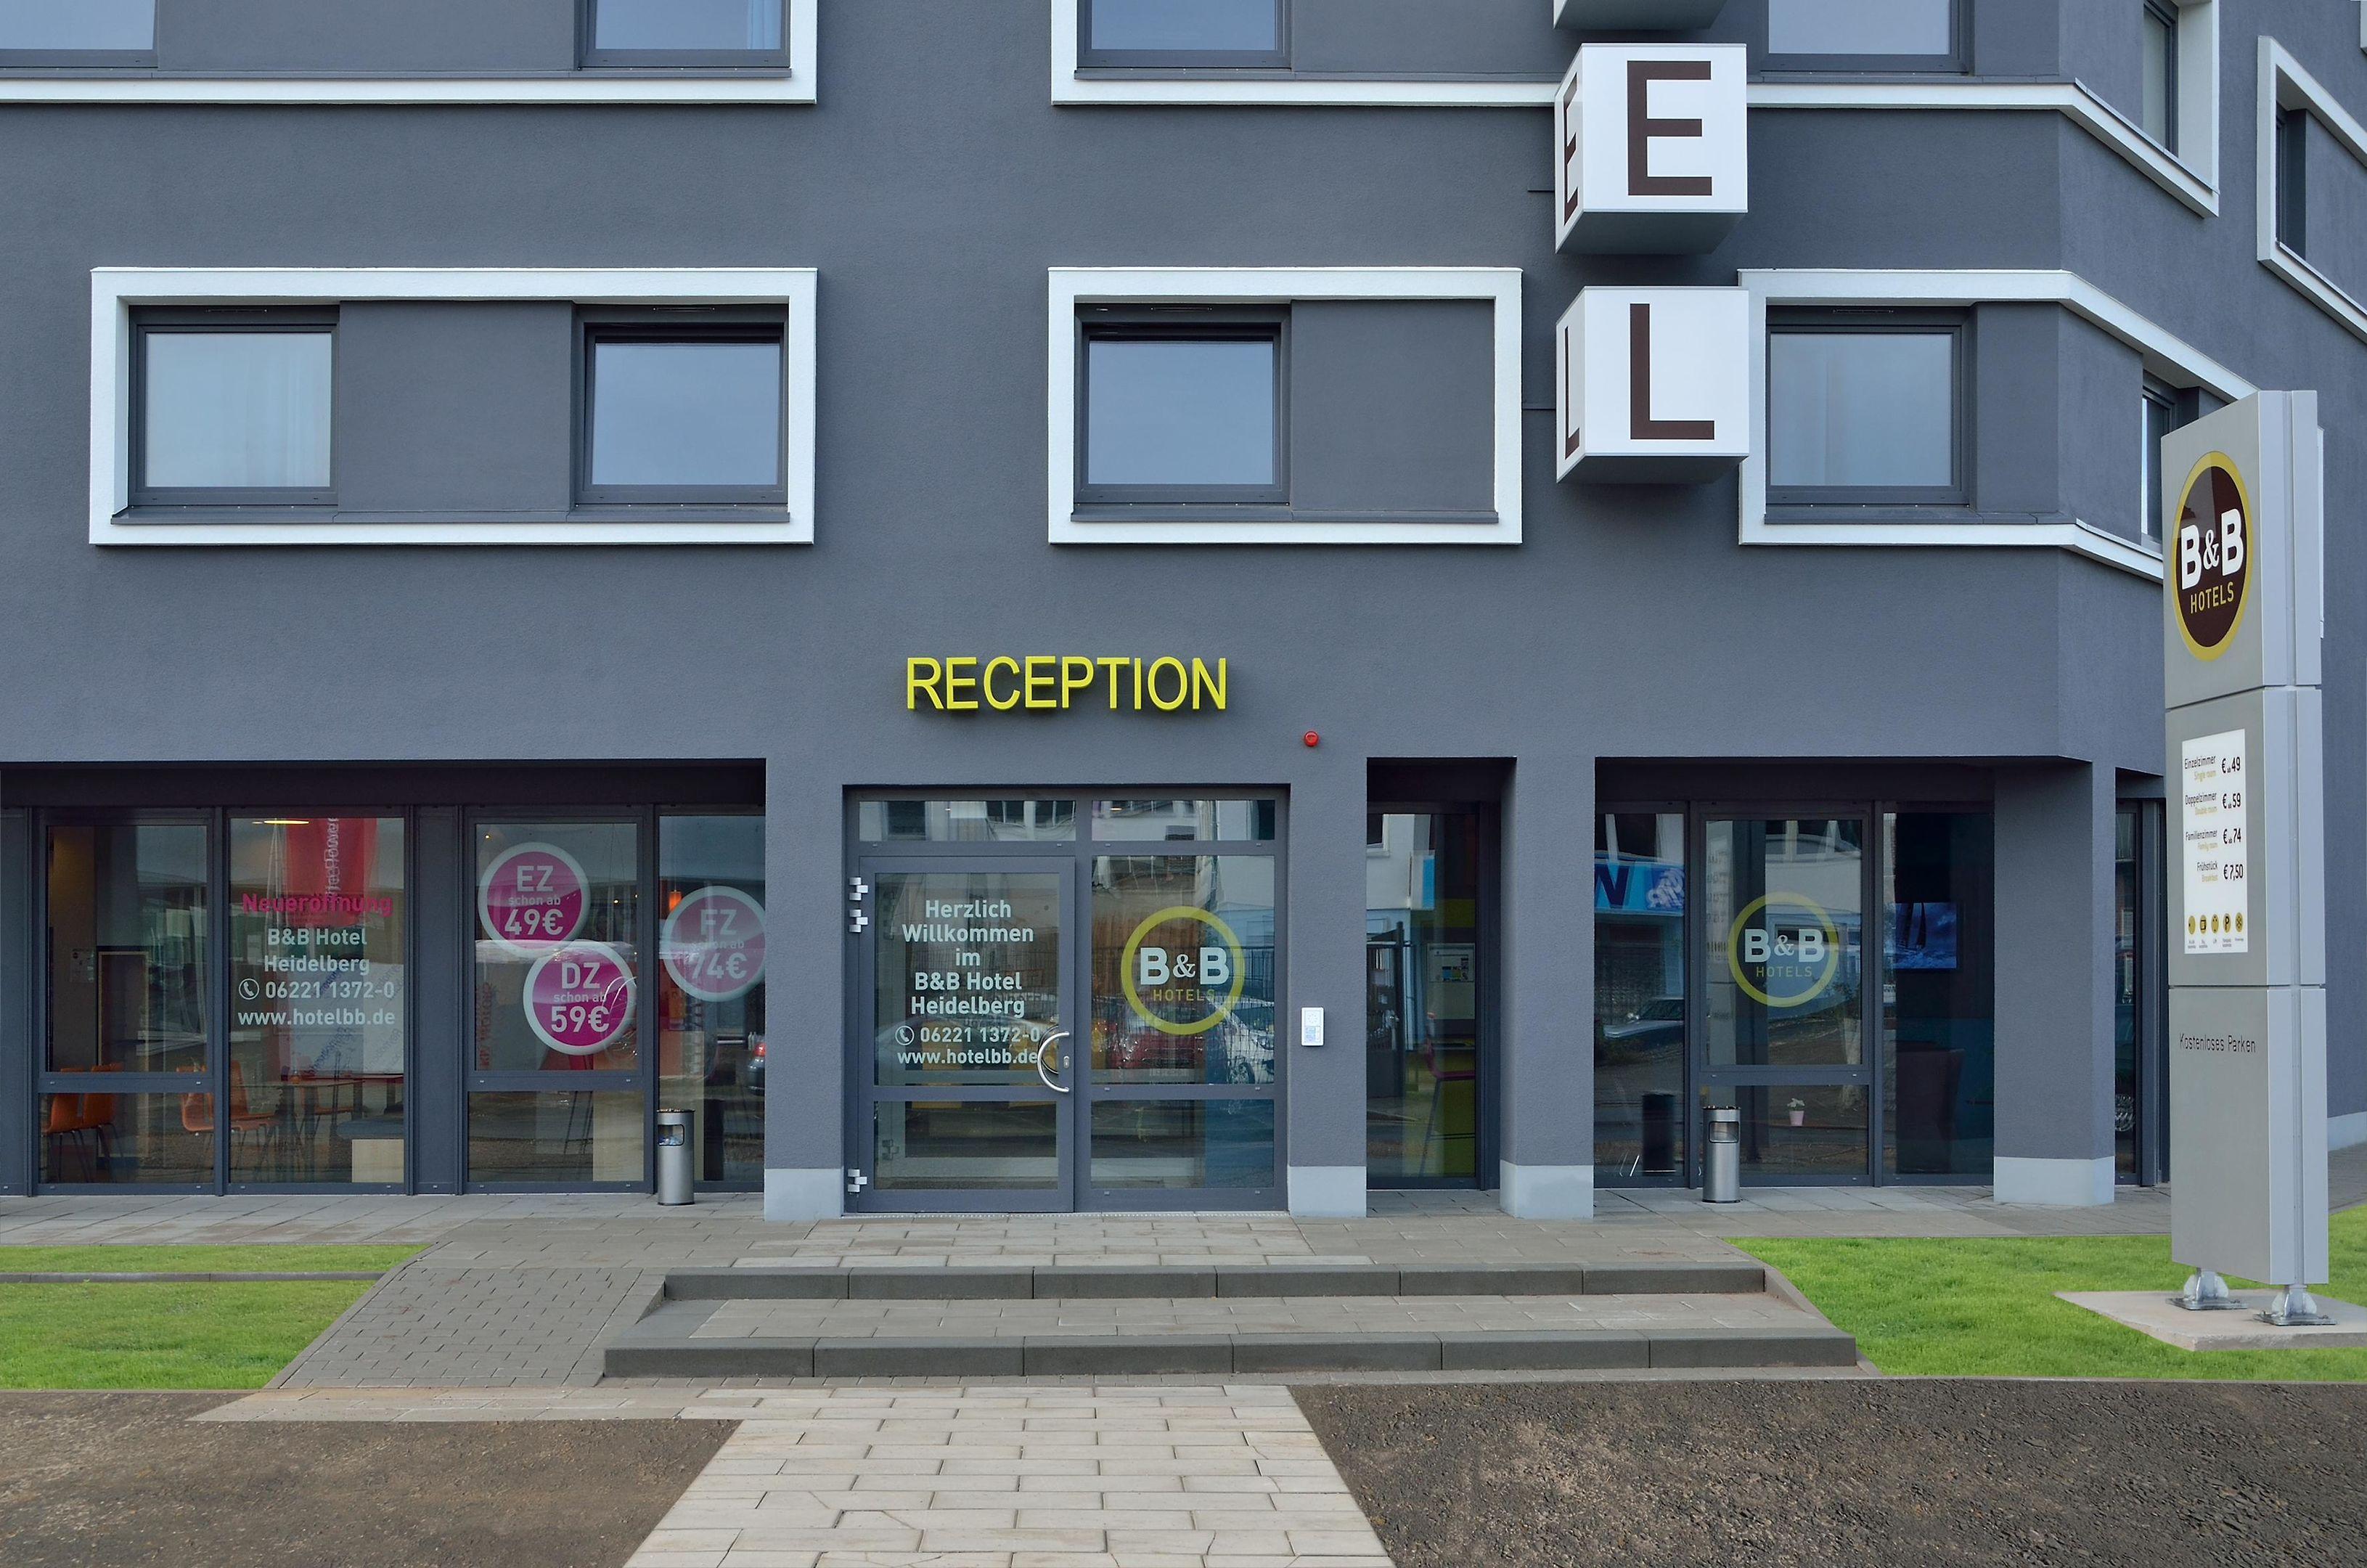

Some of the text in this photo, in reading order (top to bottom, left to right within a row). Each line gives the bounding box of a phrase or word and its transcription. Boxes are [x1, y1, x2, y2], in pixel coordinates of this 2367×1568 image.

[1627, 60, 1712, 196] E
[1630, 303, 1714, 440] L
[2181, 508, 2244, 590] B&B
[2191, 581, 2234, 614] HOTELS
[907, 656, 1226, 711] RECEPTION
[2184, 756, 2216, 769] Einzelzimmer
[2231, 756, 2241, 772] 49
[2185, 793, 2217, 807] Doppelzimmer
[2233, 793, 2241, 807] 59
[2186, 830, 2217, 841] Familienzimmer
[2233, 828, 2241, 843] 74
[517, 865, 554, 891] EZ
[2196, 860, 2218, 871] Frühstück
[2230, 864, 2244, 880] 7,50
[242, 892, 394, 918] Neueröffnung
[508, 895, 561, 906] schon ab
[925, 899, 1011, 918] Herzlich
[504, 909, 563, 936] 49€
[267, 928, 367, 946] B&B Hotel
[902, 923, 1034, 942] Willkommen
[730, 939, 745, 949] ab
[1744, 928, 1825, 963] B&B
[264, 955, 371, 975] Heidelberg
[690, 952, 748, 979] 74€
[955, 948, 981, 966] im
[1140, 947, 1230, 985] B&B
[561, 962, 600, 989] DZ
[915, 972, 1022, 990] B&B Hotel
[1756, 966, 1812, 978] HOTELS
[266, 981, 395, 999] 06221 1372-0
[553, 992, 607, 1003] schon ab
[1153, 989, 1215, 1002] HOTELS
[238, 1008, 396, 1025] www.hotelbb.de
[910, 997, 1025, 1018] Heidelberg
[551, 1006, 610, 1033] 59€
[920, 1026, 1040, 1043] 06221 1372-0
[2180, 1033, 2256, 1053] Kostenloses Parken
[897, 1048, 1038, 1066] www.hotelbb.de
